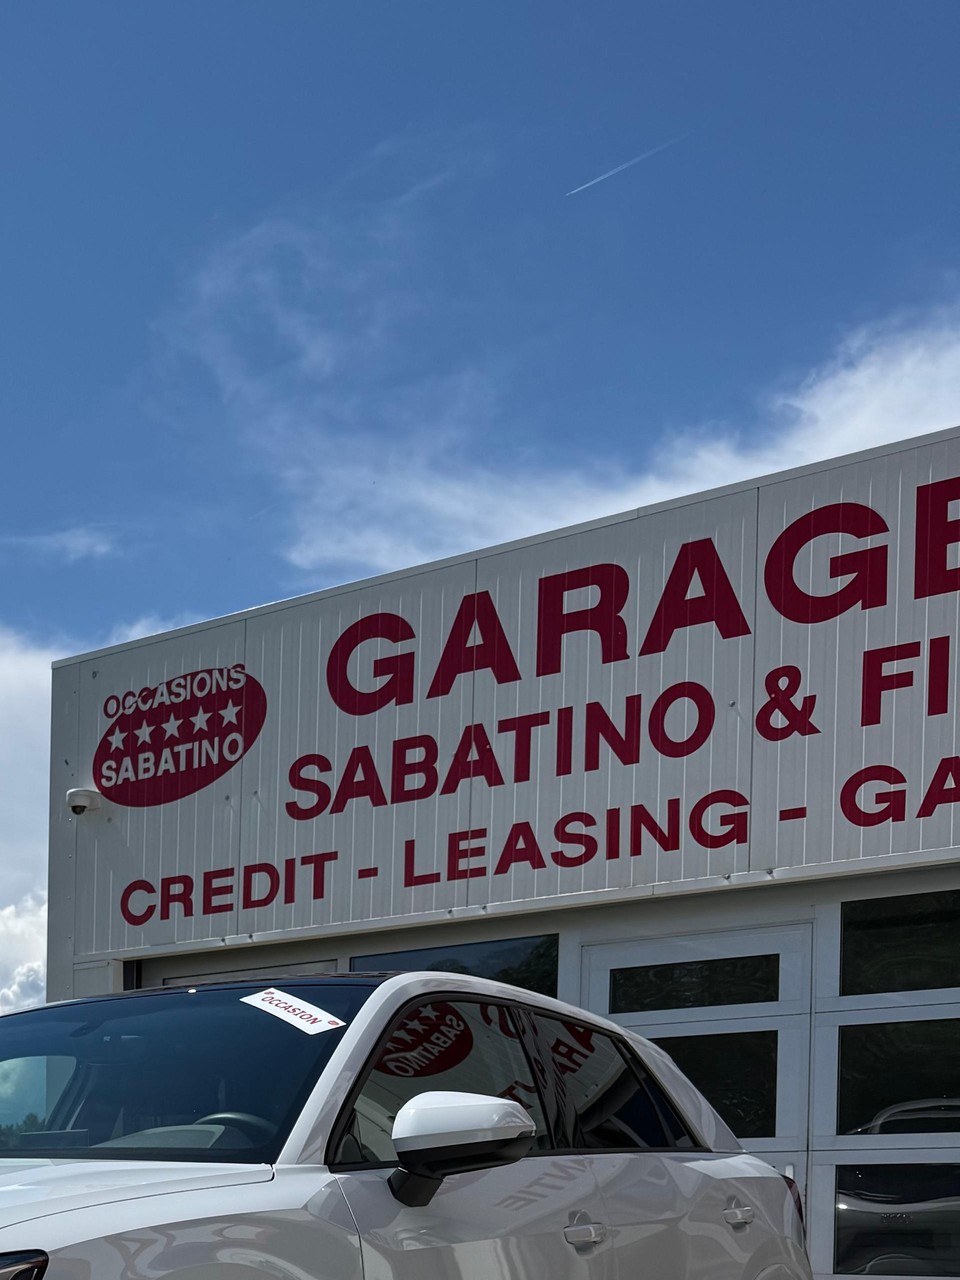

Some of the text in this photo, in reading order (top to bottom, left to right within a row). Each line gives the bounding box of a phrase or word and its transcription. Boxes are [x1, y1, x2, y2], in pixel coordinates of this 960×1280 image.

[103, 663, 247, 719] OCCASIONS
[100, 732, 245, 788] SABATINO
[286, 682, 715, 821] SABATINO
[756, 665, 821, 741] &
[120, 851, 338, 926] CREDIT
[404, 789, 750, 887] LEASING
[261, 996, 322, 1025] OCCASION
